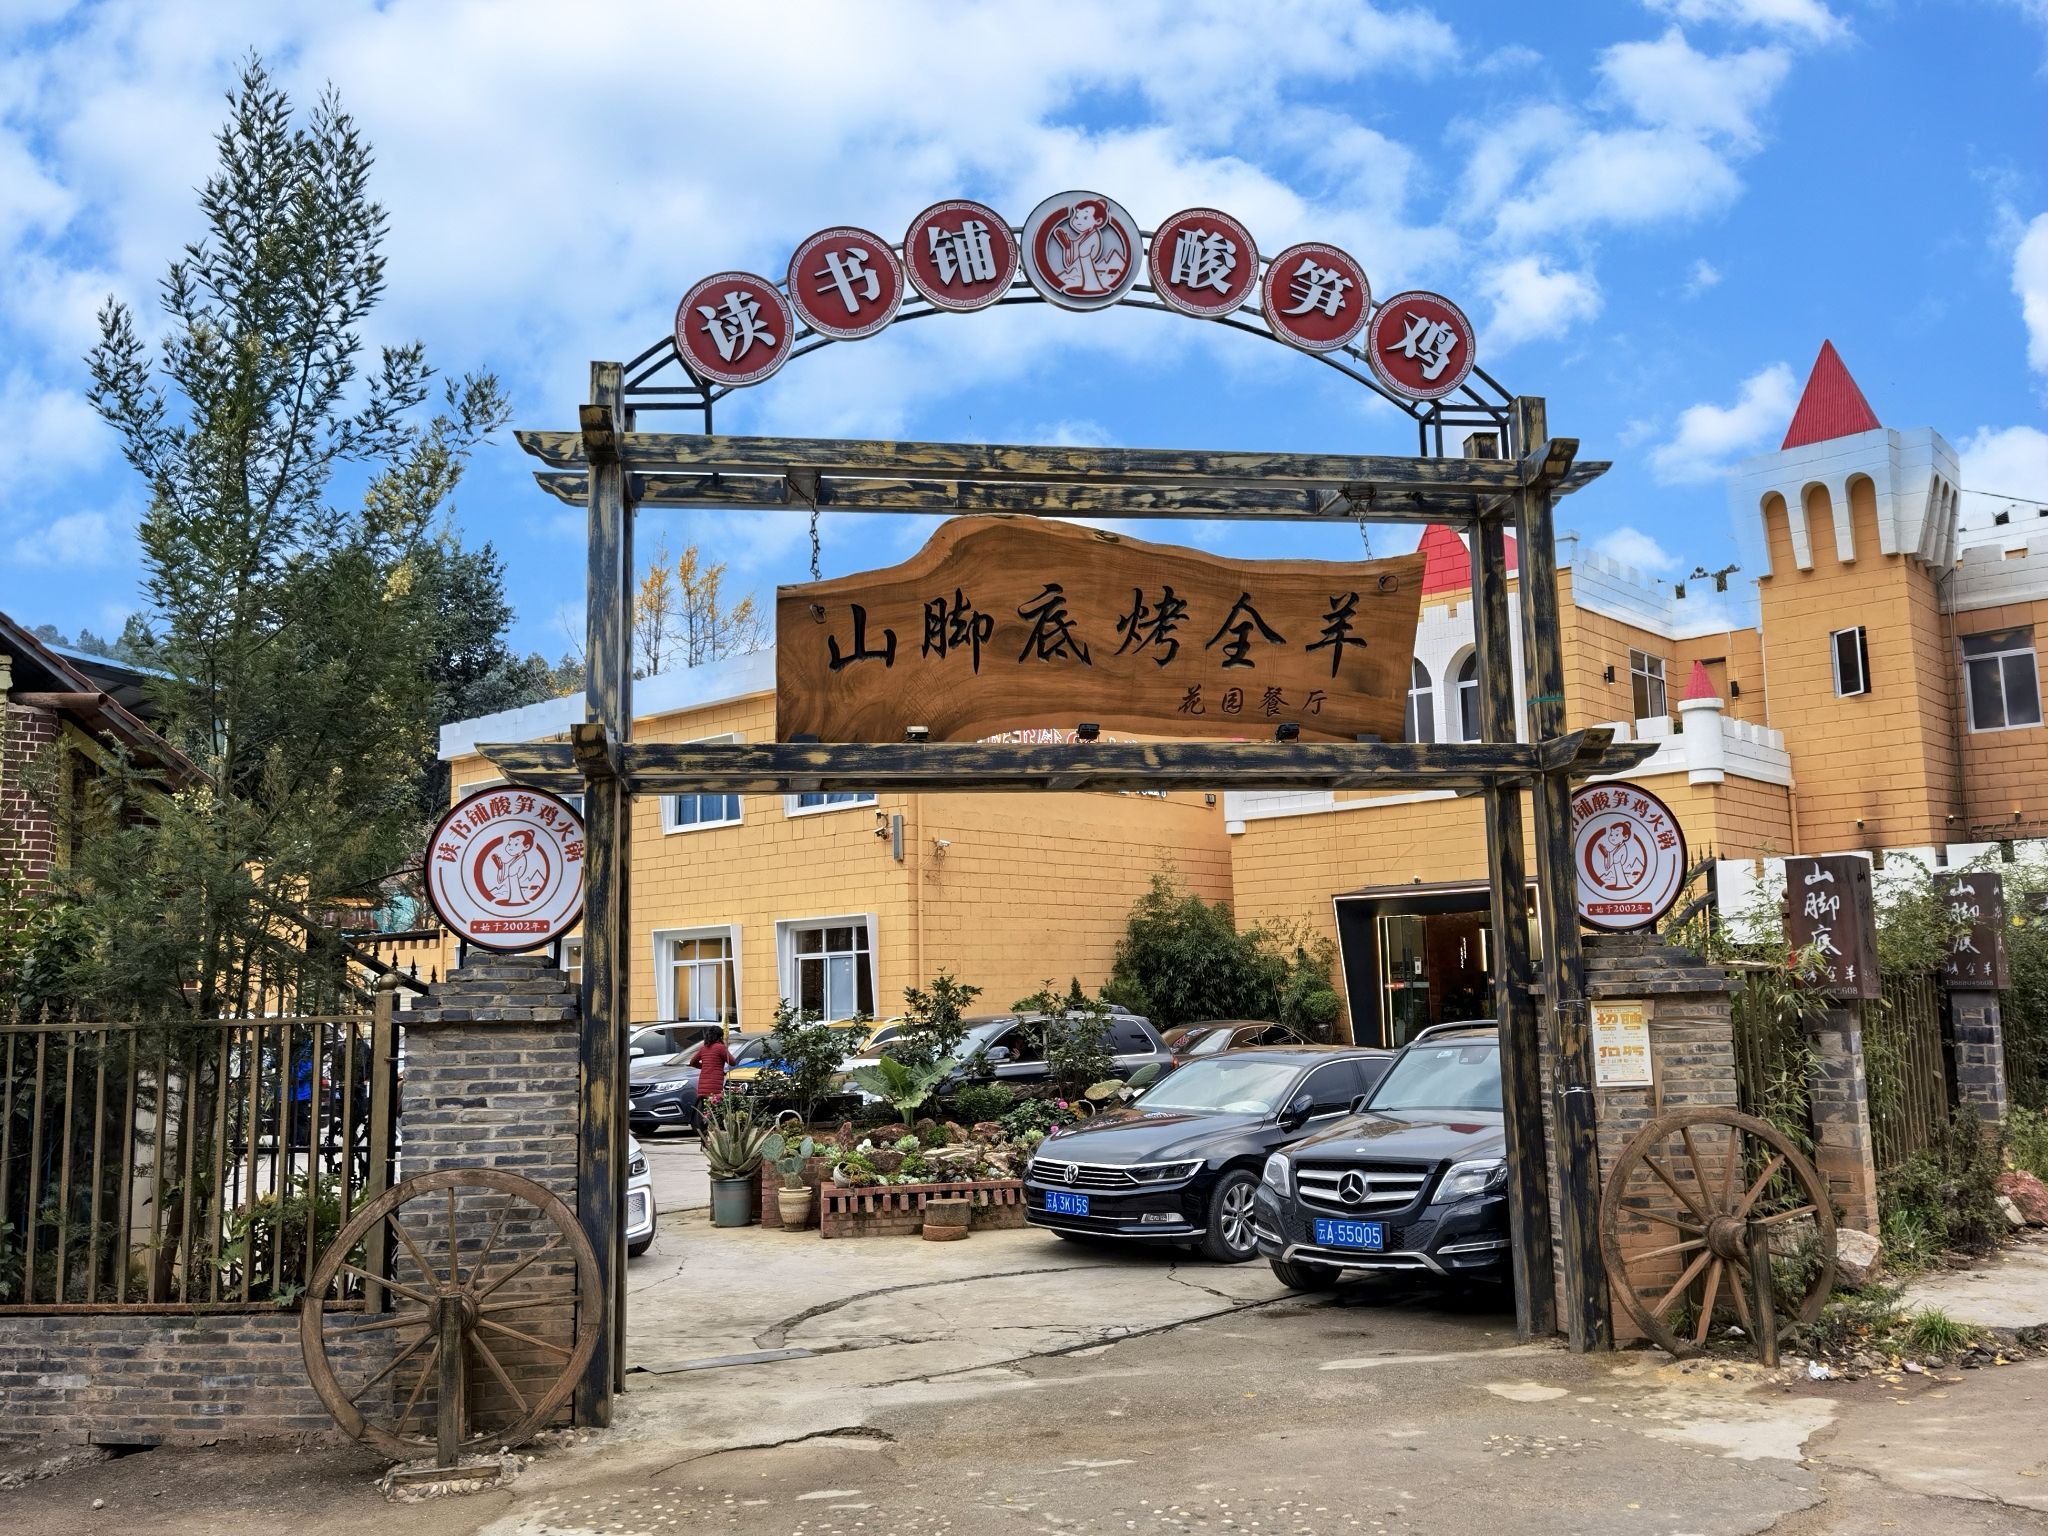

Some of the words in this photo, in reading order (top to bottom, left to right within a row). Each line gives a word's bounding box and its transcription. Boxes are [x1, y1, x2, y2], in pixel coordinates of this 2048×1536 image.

[696, 220, 997, 362] 读书铺
[1170, 228, 1459, 380] 酸笋鸡
[828, 583, 1367, 677] 山脚底烤全羊
[1178, 684, 1327, 717] 花园餐厅
[436, 794, 584, 863] 读书铺酸笋鸡火锅
[480, 922, 540, 932] 始于2002年
[1804, 862, 1842, 955] 山脚底
